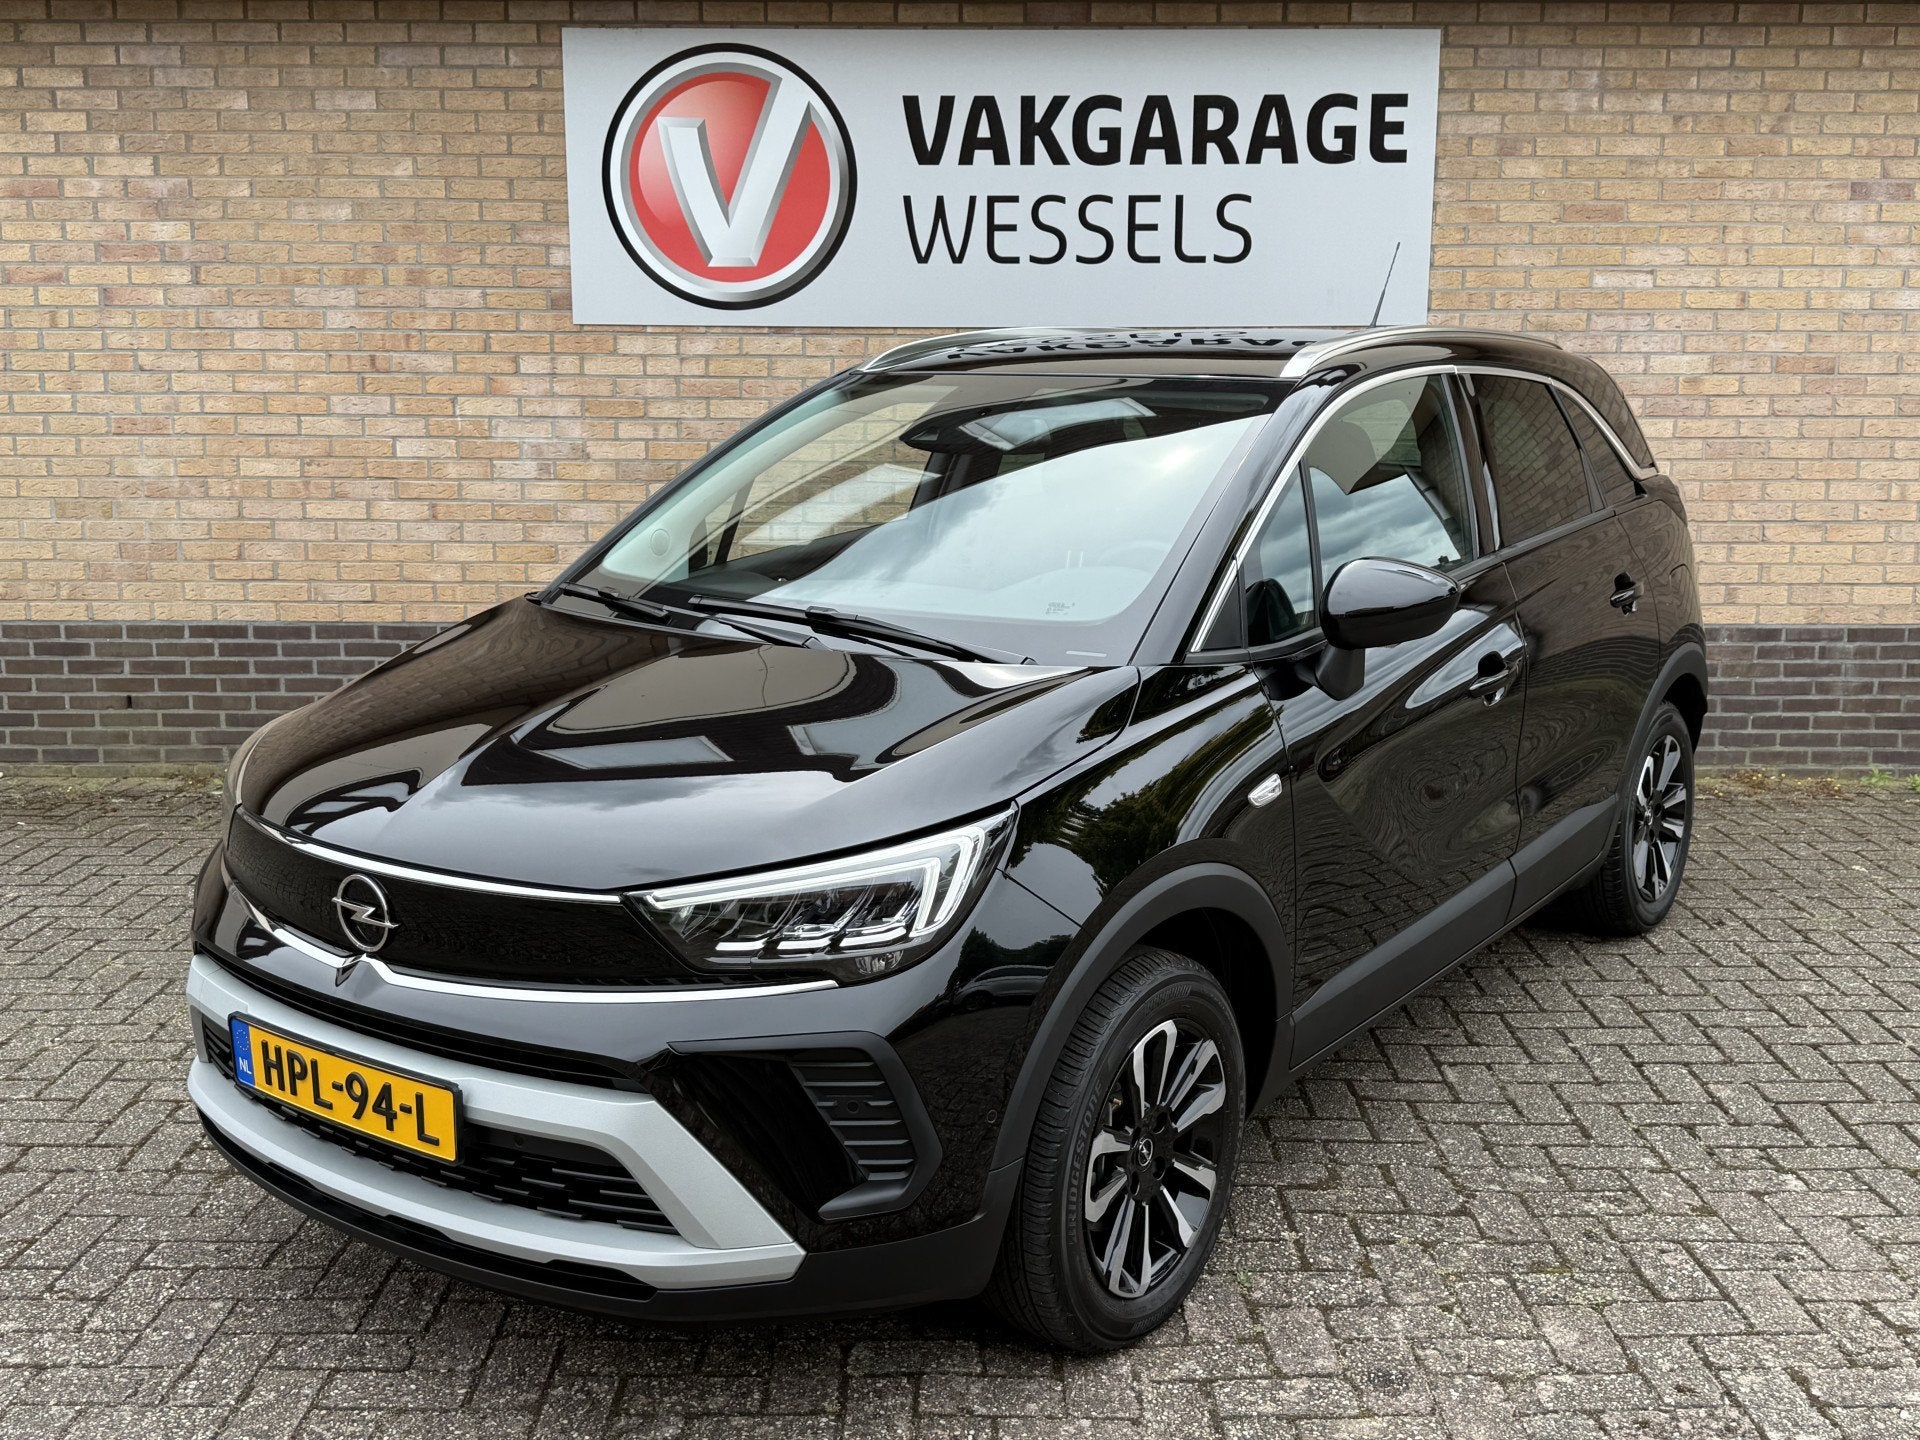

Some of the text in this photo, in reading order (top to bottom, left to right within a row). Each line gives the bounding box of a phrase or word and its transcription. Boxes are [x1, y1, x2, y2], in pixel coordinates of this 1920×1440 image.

[903, 93, 1408, 166] VAKGARAGE
[659, 75, 816, 268] V
[903, 194, 1251, 264] WESSELS
[239, 1056, 252, 1075] NL
[261, 1039, 440, 1147] HPL-94-L
